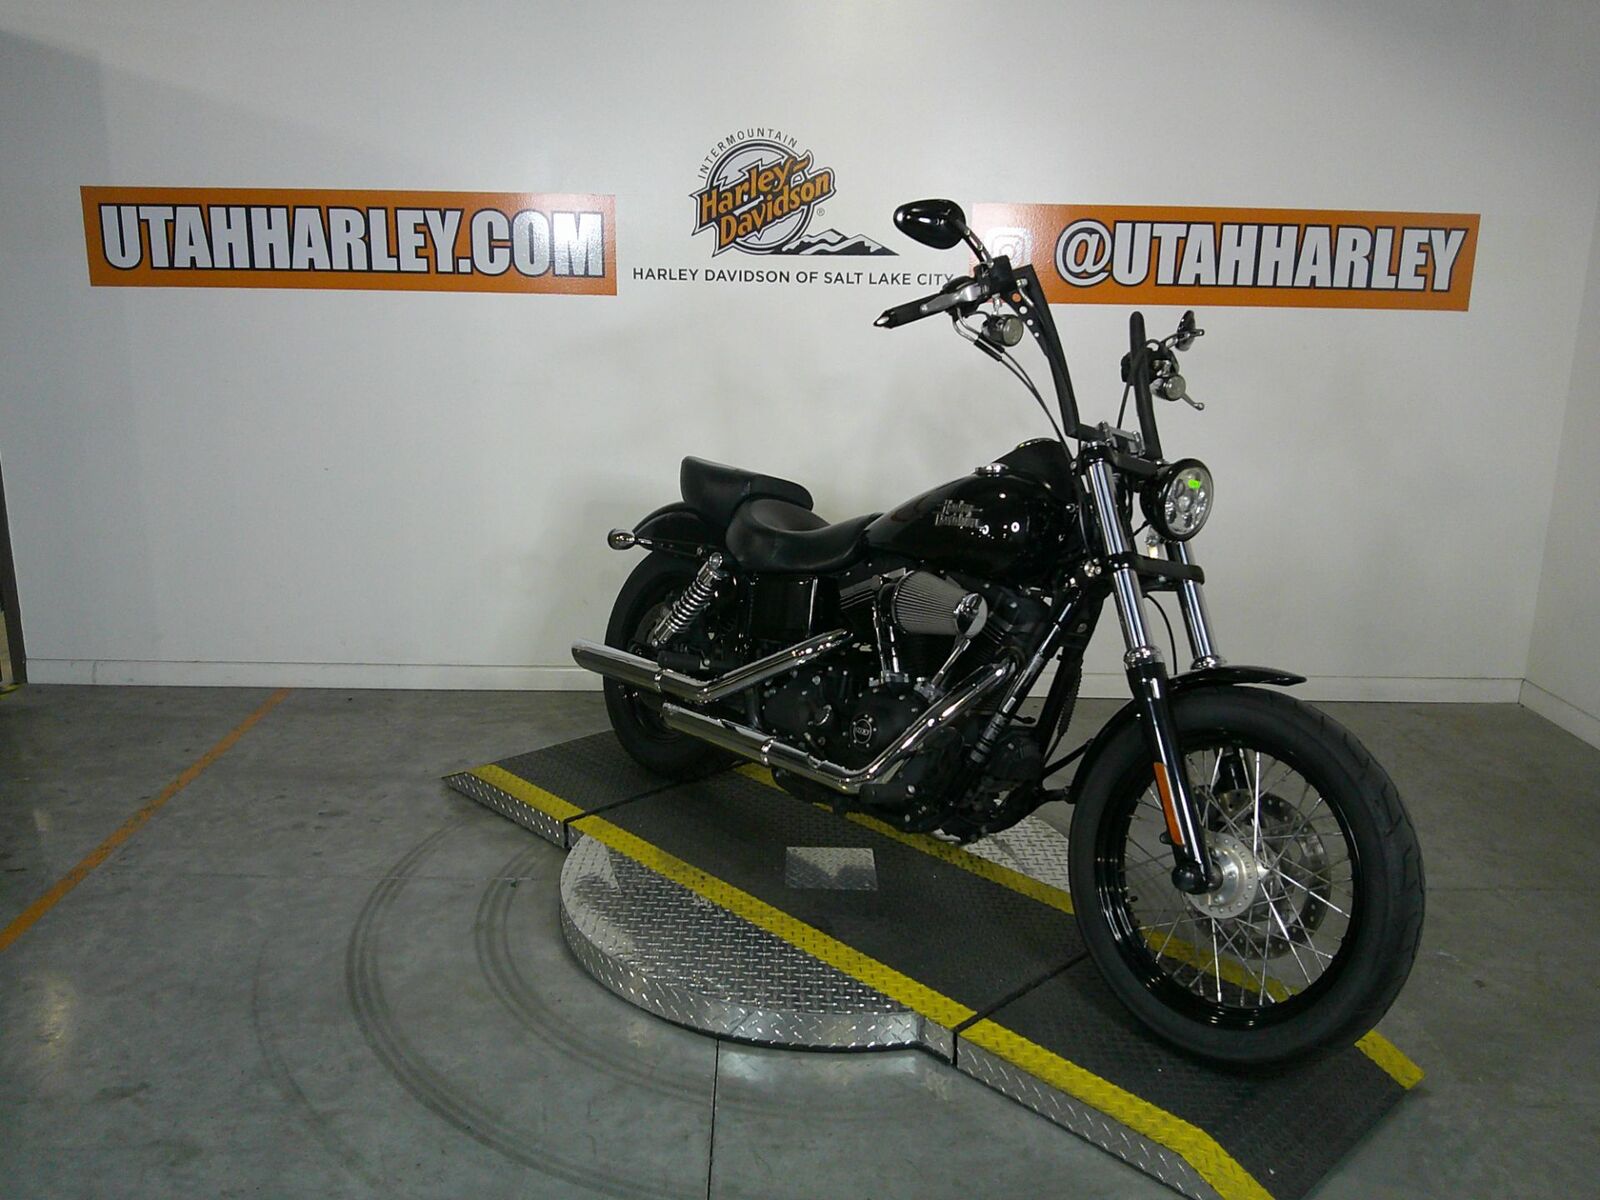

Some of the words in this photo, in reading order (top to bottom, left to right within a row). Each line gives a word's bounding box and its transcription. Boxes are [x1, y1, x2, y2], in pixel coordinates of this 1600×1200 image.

[697, 128, 797, 179] INTERMOUNTAIN
[99, 203, 605, 278] UTAHHARLEY.COM
[720, 171, 830, 246] Davidson
[633, 267, 698, 281] HARLEY
[704, 268, 790, 283] DAVIDSON
[796, 271, 819, 284] OF
[823, 271, 864, 285] SALT
[868, 272, 911, 286] LAKE
[917, 273, 954, 286] CITY
[1054, 218, 1467, 293] @UTAHHARLEY
